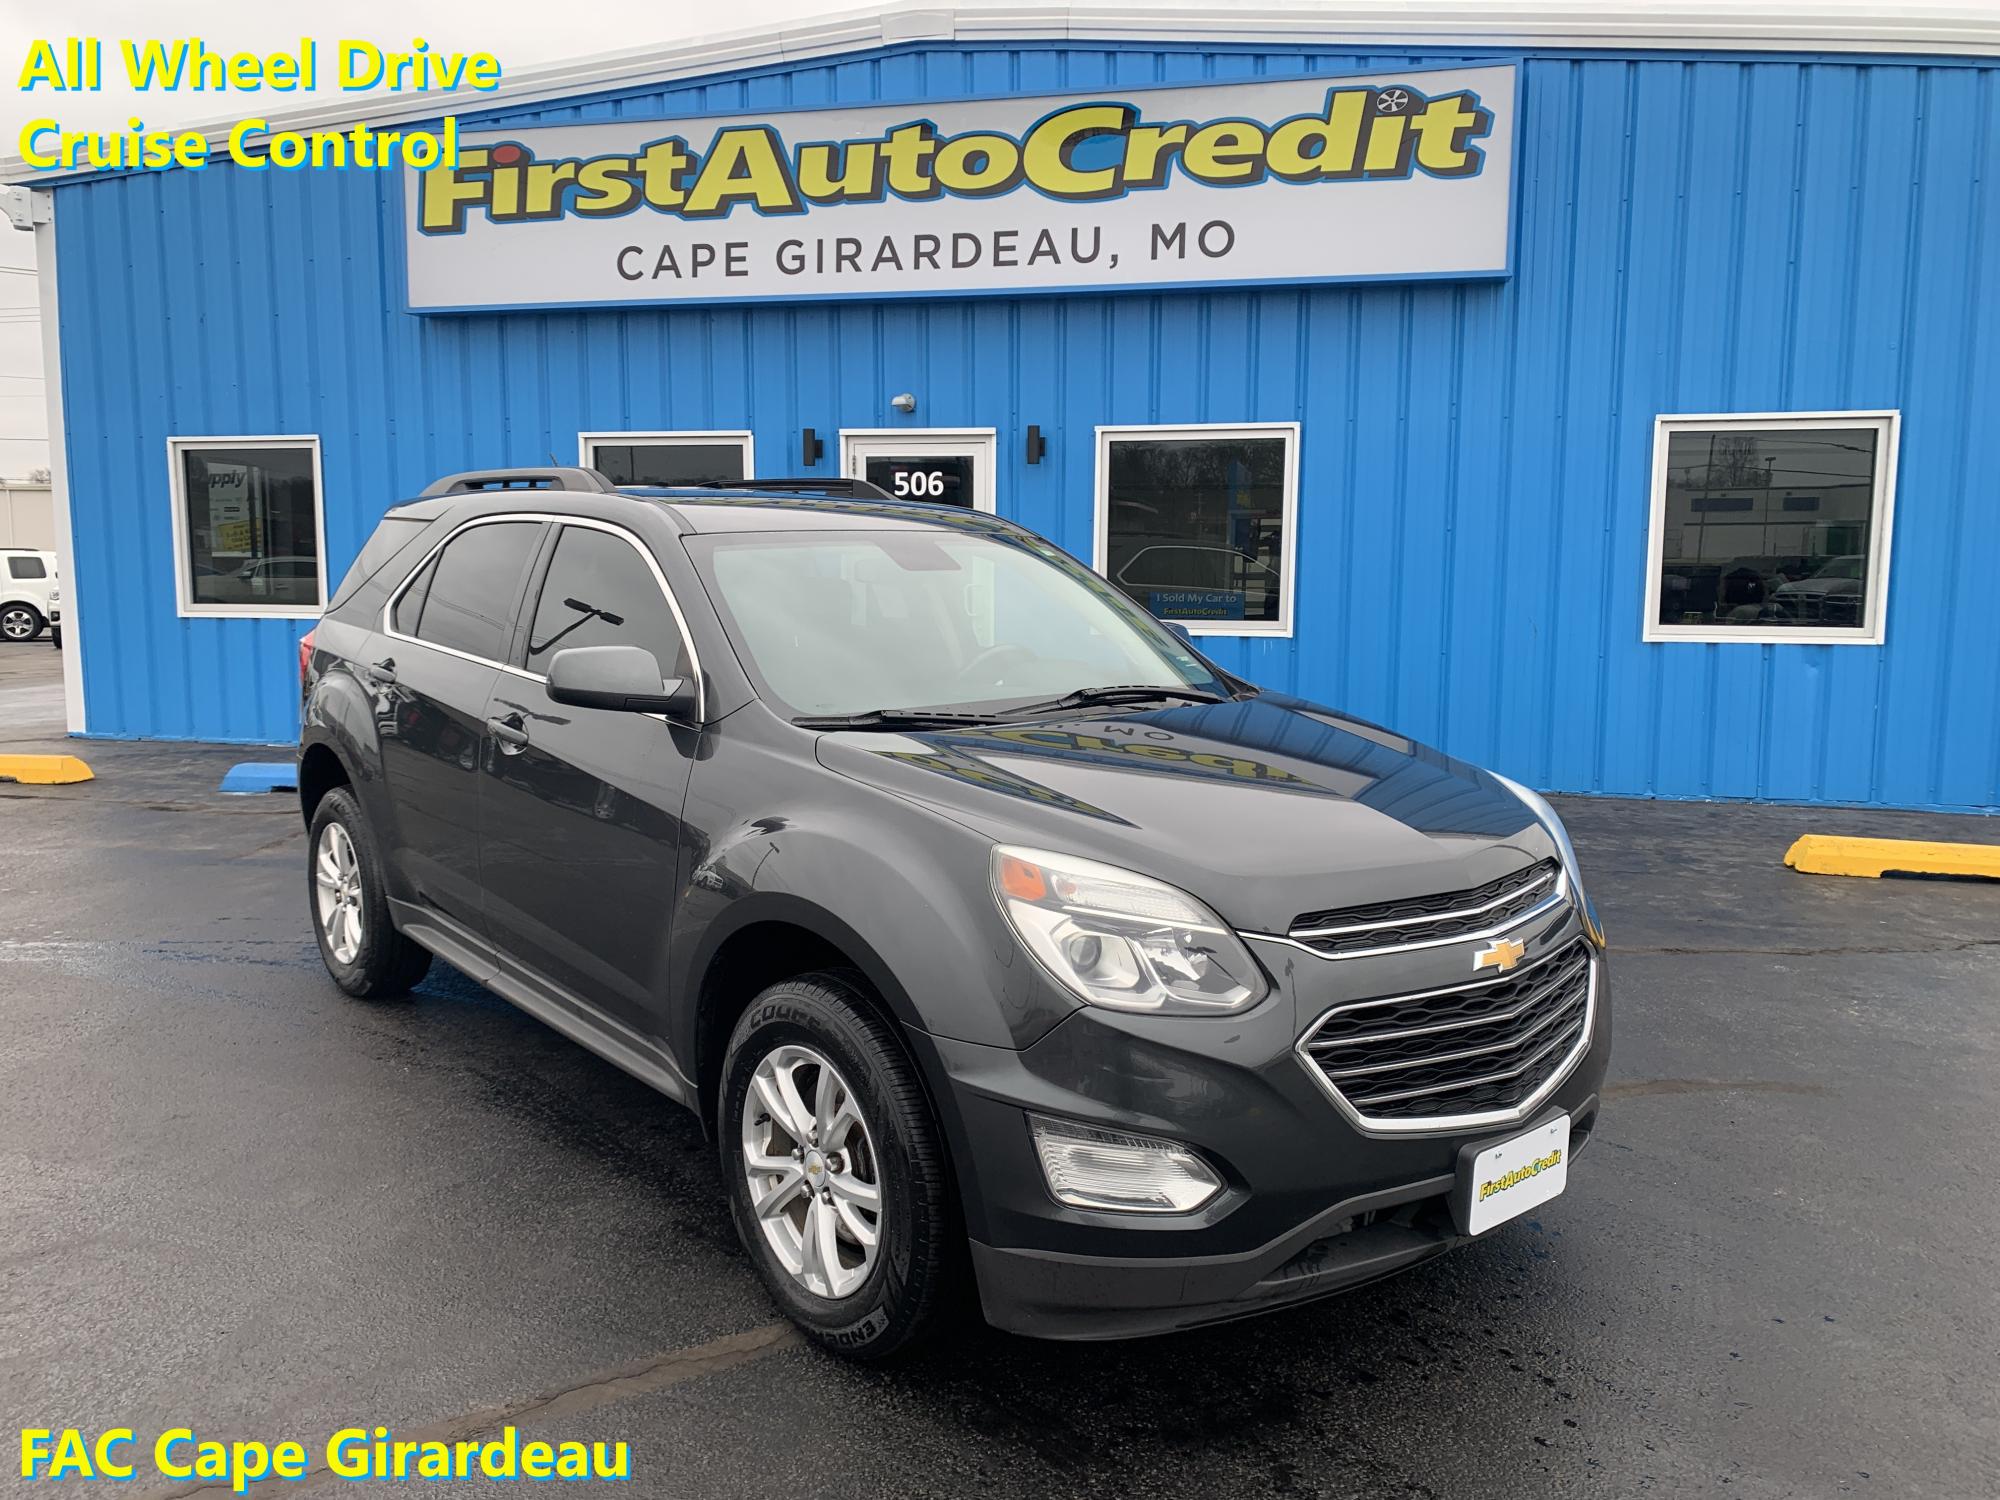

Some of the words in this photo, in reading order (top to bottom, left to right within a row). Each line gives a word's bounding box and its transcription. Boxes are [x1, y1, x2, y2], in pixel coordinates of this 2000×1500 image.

[420, 86, 1492, 233] FirstAutoCredit
[617, 241, 750, 280] CAPE
[776, 227, 1119, 275] GIRARDEAU,
[1150, 220, 1236, 261] MO
[893, 471, 945, 496] 506
[1162, 593, 1186, 602] Sold
[1188, 594, 1203, 604] My
[1205, 594, 1224, 602] Car
[1479, 1149, 1562, 1202] FirstAutoCredit
